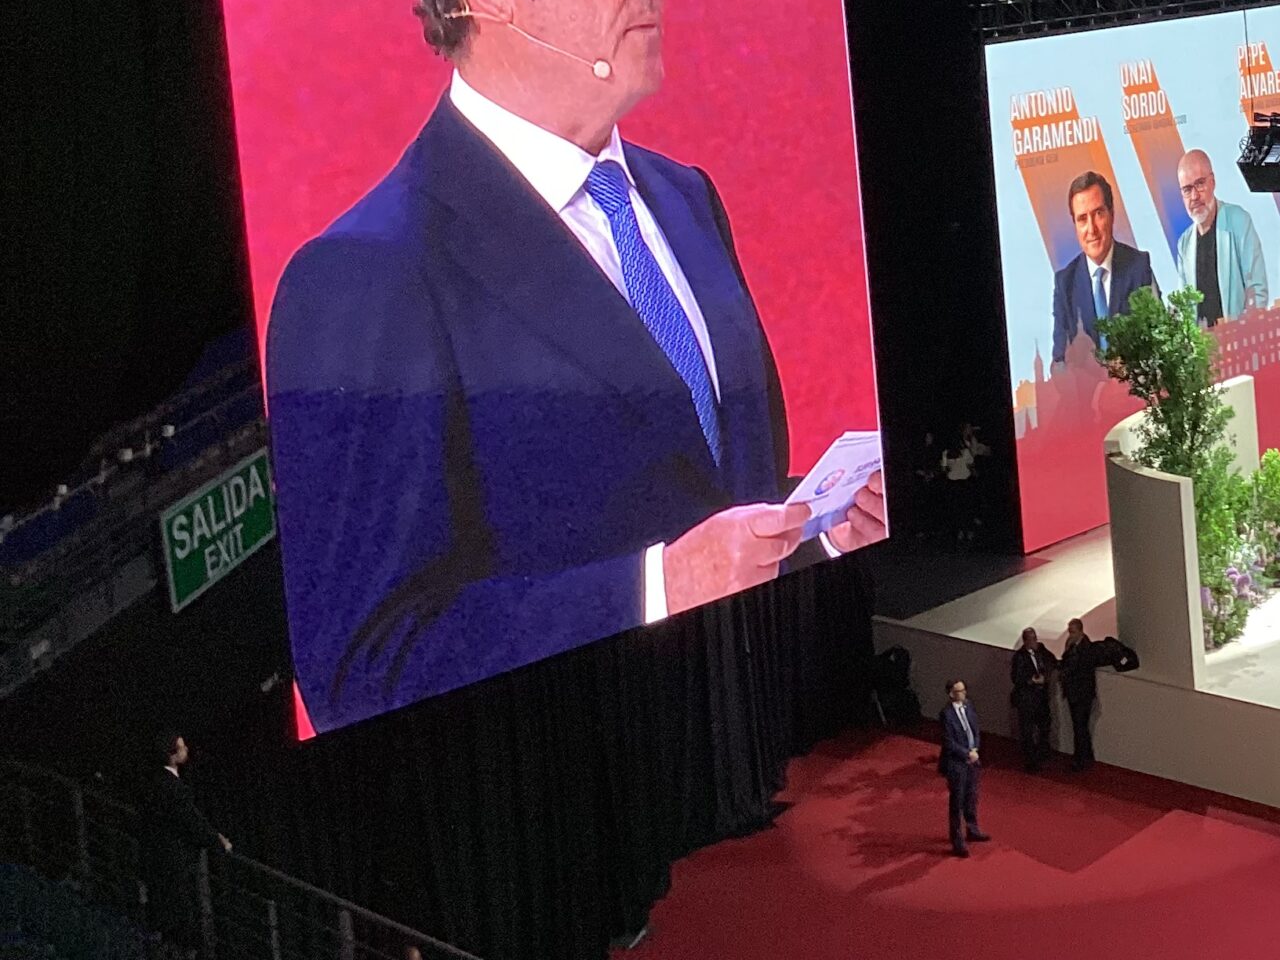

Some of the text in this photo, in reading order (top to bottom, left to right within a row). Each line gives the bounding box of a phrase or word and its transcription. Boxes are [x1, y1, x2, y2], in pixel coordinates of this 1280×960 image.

[1237, 41, 1266, 68] PEPE
[1120, 59, 1153, 88] UNAI
[1010, 86, 1073, 121] ANTONIO
[1123, 90, 1166, 120] SORDO
[1013, 116, 1098, 156] GARAMENDI
[171, 464, 266, 560] SALIDA
[204, 523, 244, 579] EXIT
